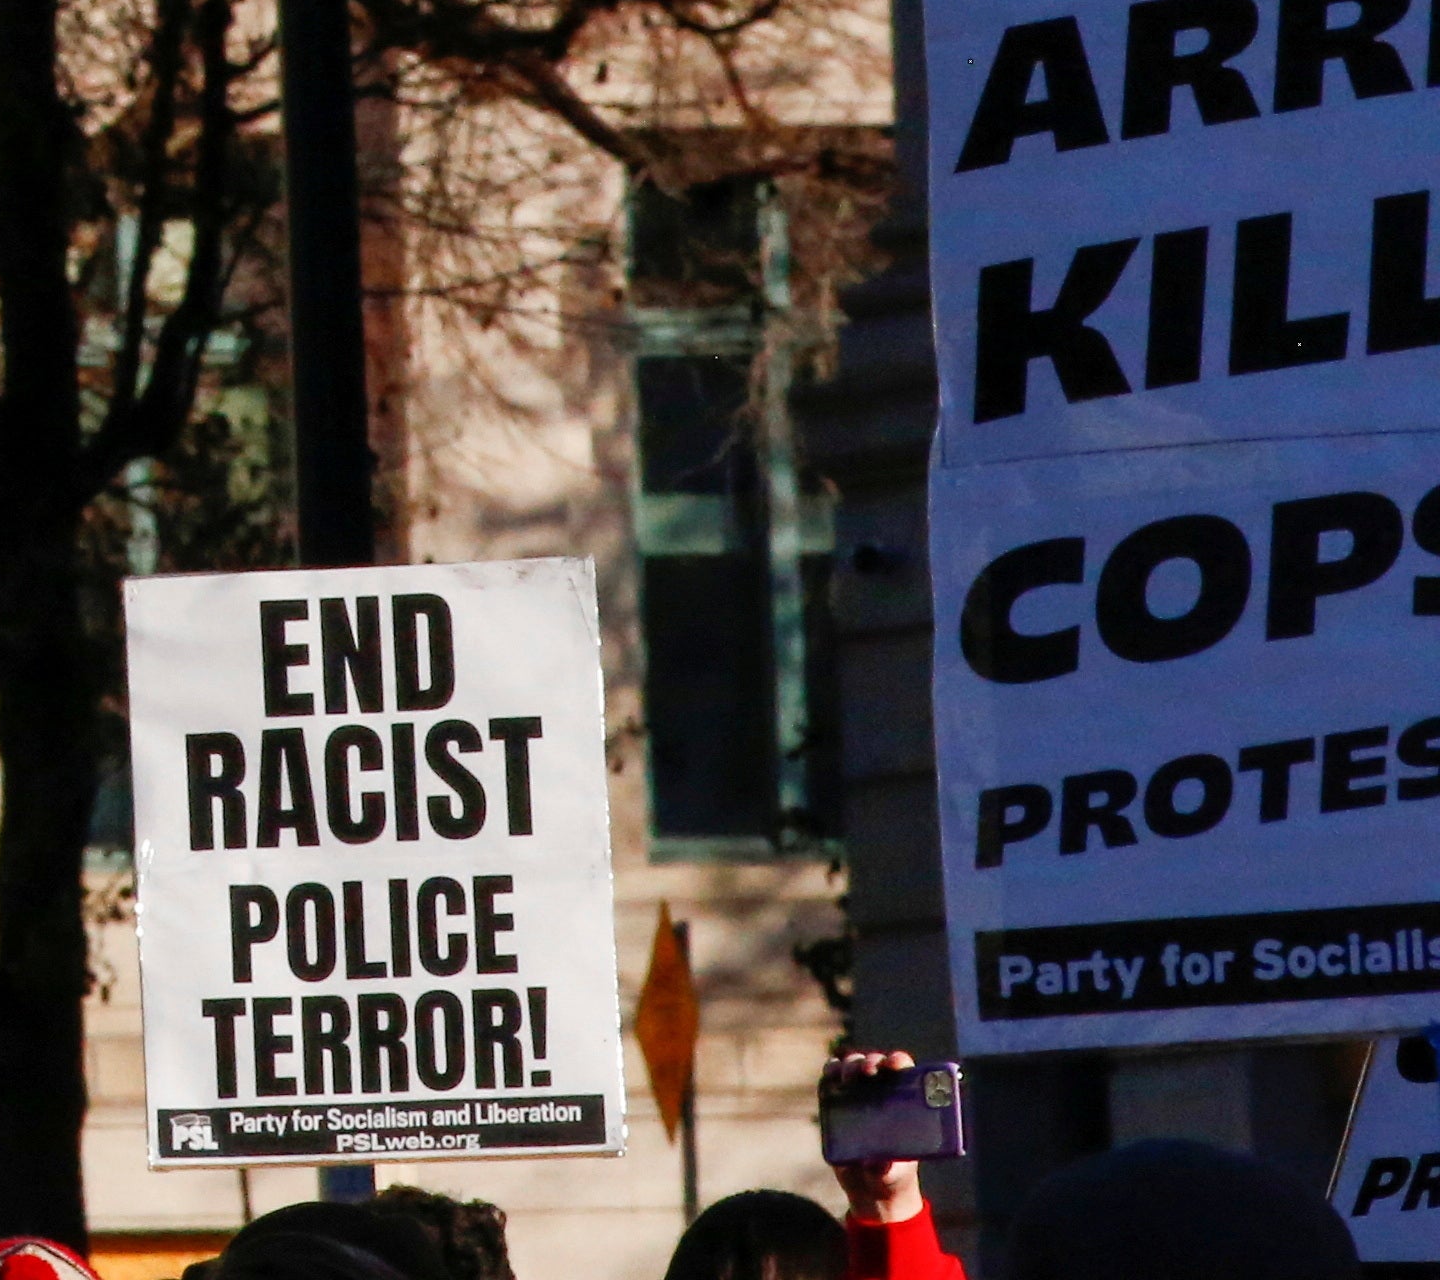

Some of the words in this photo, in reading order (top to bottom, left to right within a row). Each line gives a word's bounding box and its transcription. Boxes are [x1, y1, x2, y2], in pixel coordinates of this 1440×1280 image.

[260, 593, 455, 717] END
[186, 717, 542, 851] RACIST
[229, 875, 518, 983] POLICE
[999, 949, 1145, 1000] Party
[1160, 943, 1236, 987] for
[202, 987, 551, 1099] TERROR!
[171, 1126, 219, 1150] PSL
[229, 1111, 287, 1135] Party
[292, 1108, 324, 1131] for
[327, 1106, 427, 1130] Socialism
[431, 1104, 471, 1126] and
[474, 1102, 582, 1125] Liberation
[336, 1133, 480, 1152] PSLweb.org
